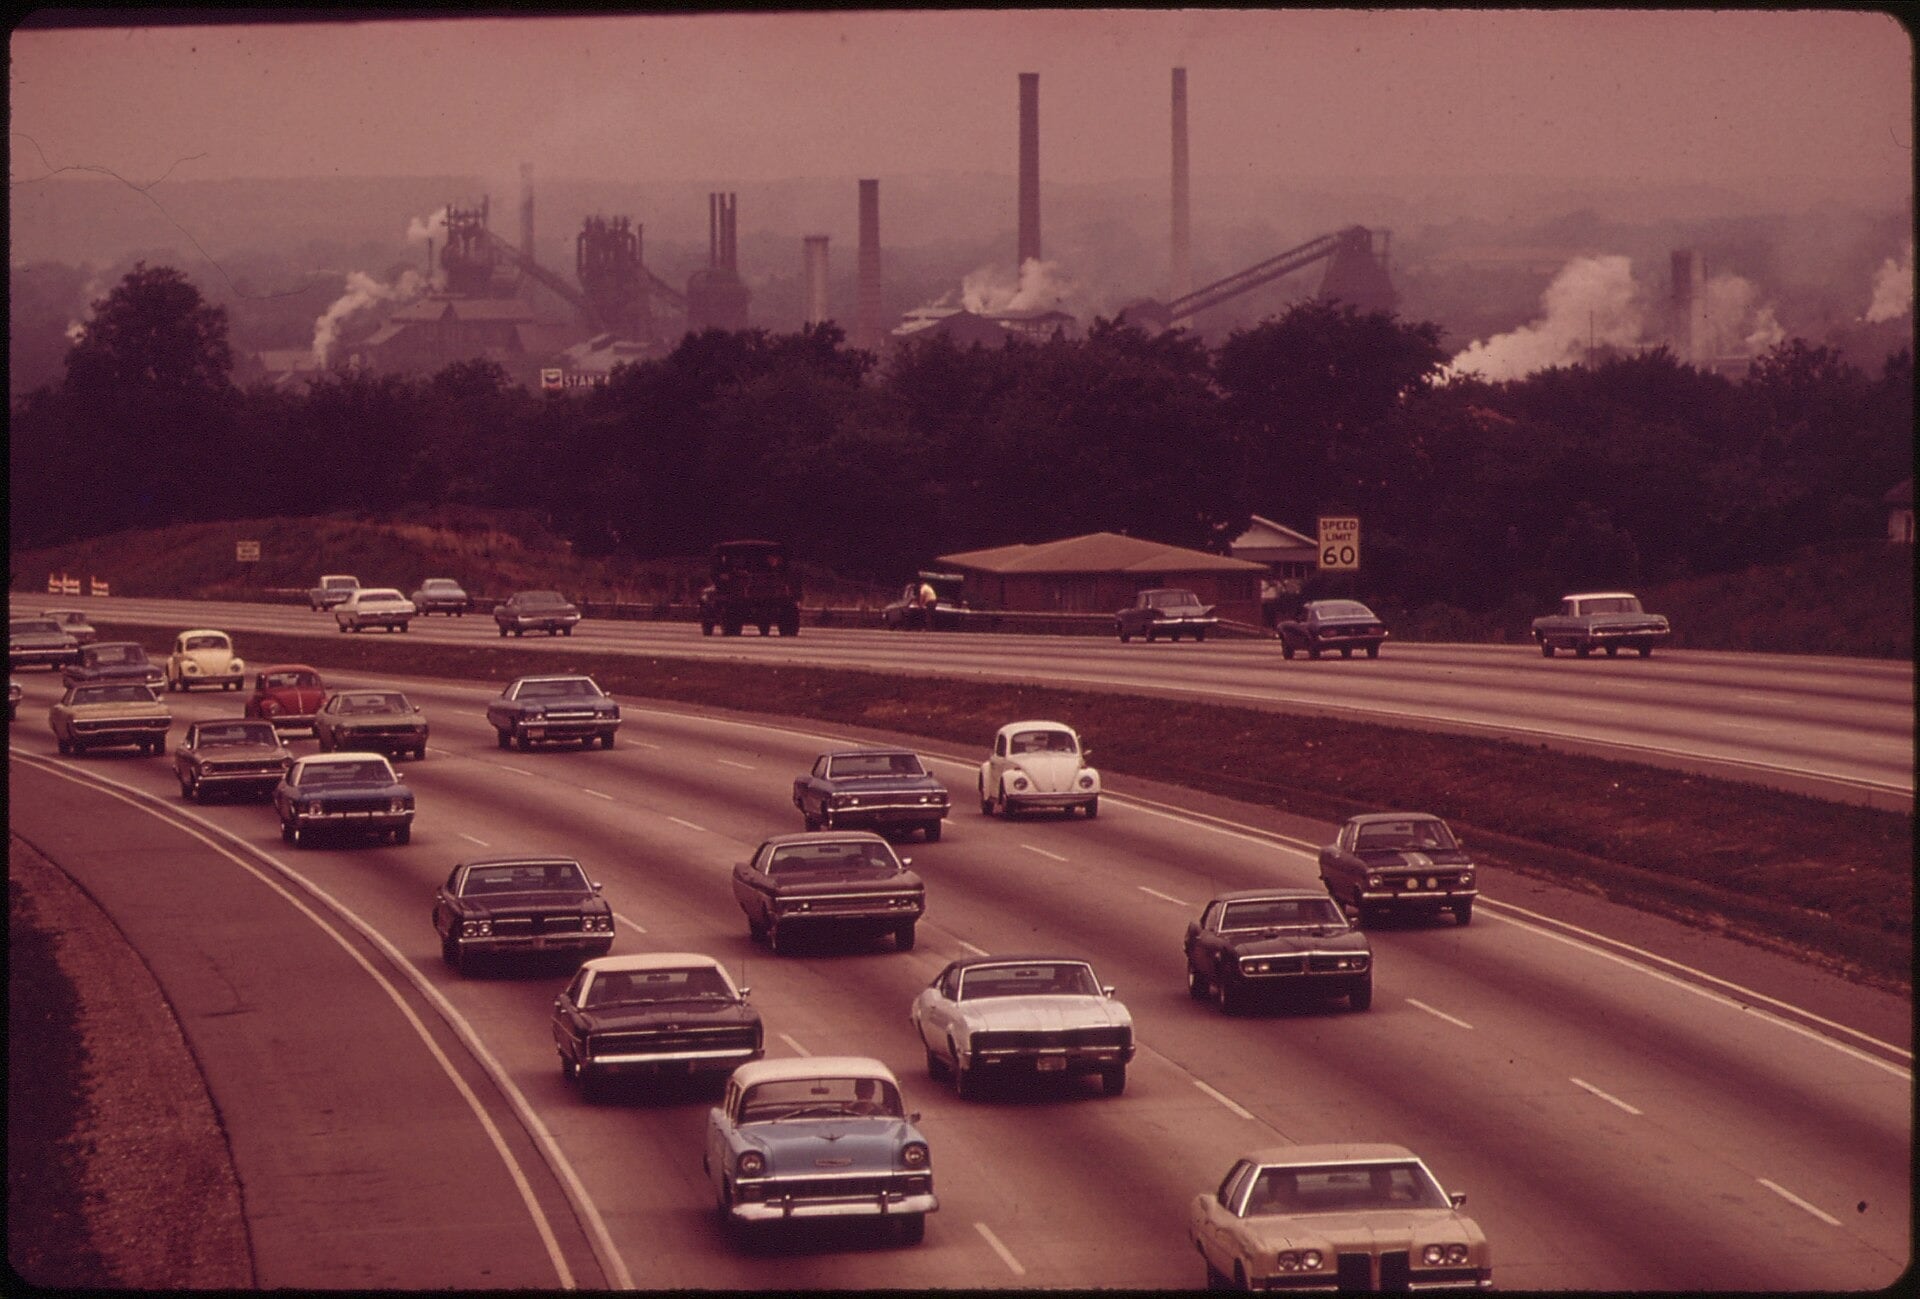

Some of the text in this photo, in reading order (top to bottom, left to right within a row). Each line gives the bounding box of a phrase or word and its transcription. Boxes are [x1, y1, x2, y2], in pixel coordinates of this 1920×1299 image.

[1322, 521, 1357, 530] SPEED
[1326, 533, 1352, 541] LIMIT
[1323, 546, 1355, 565] 60
